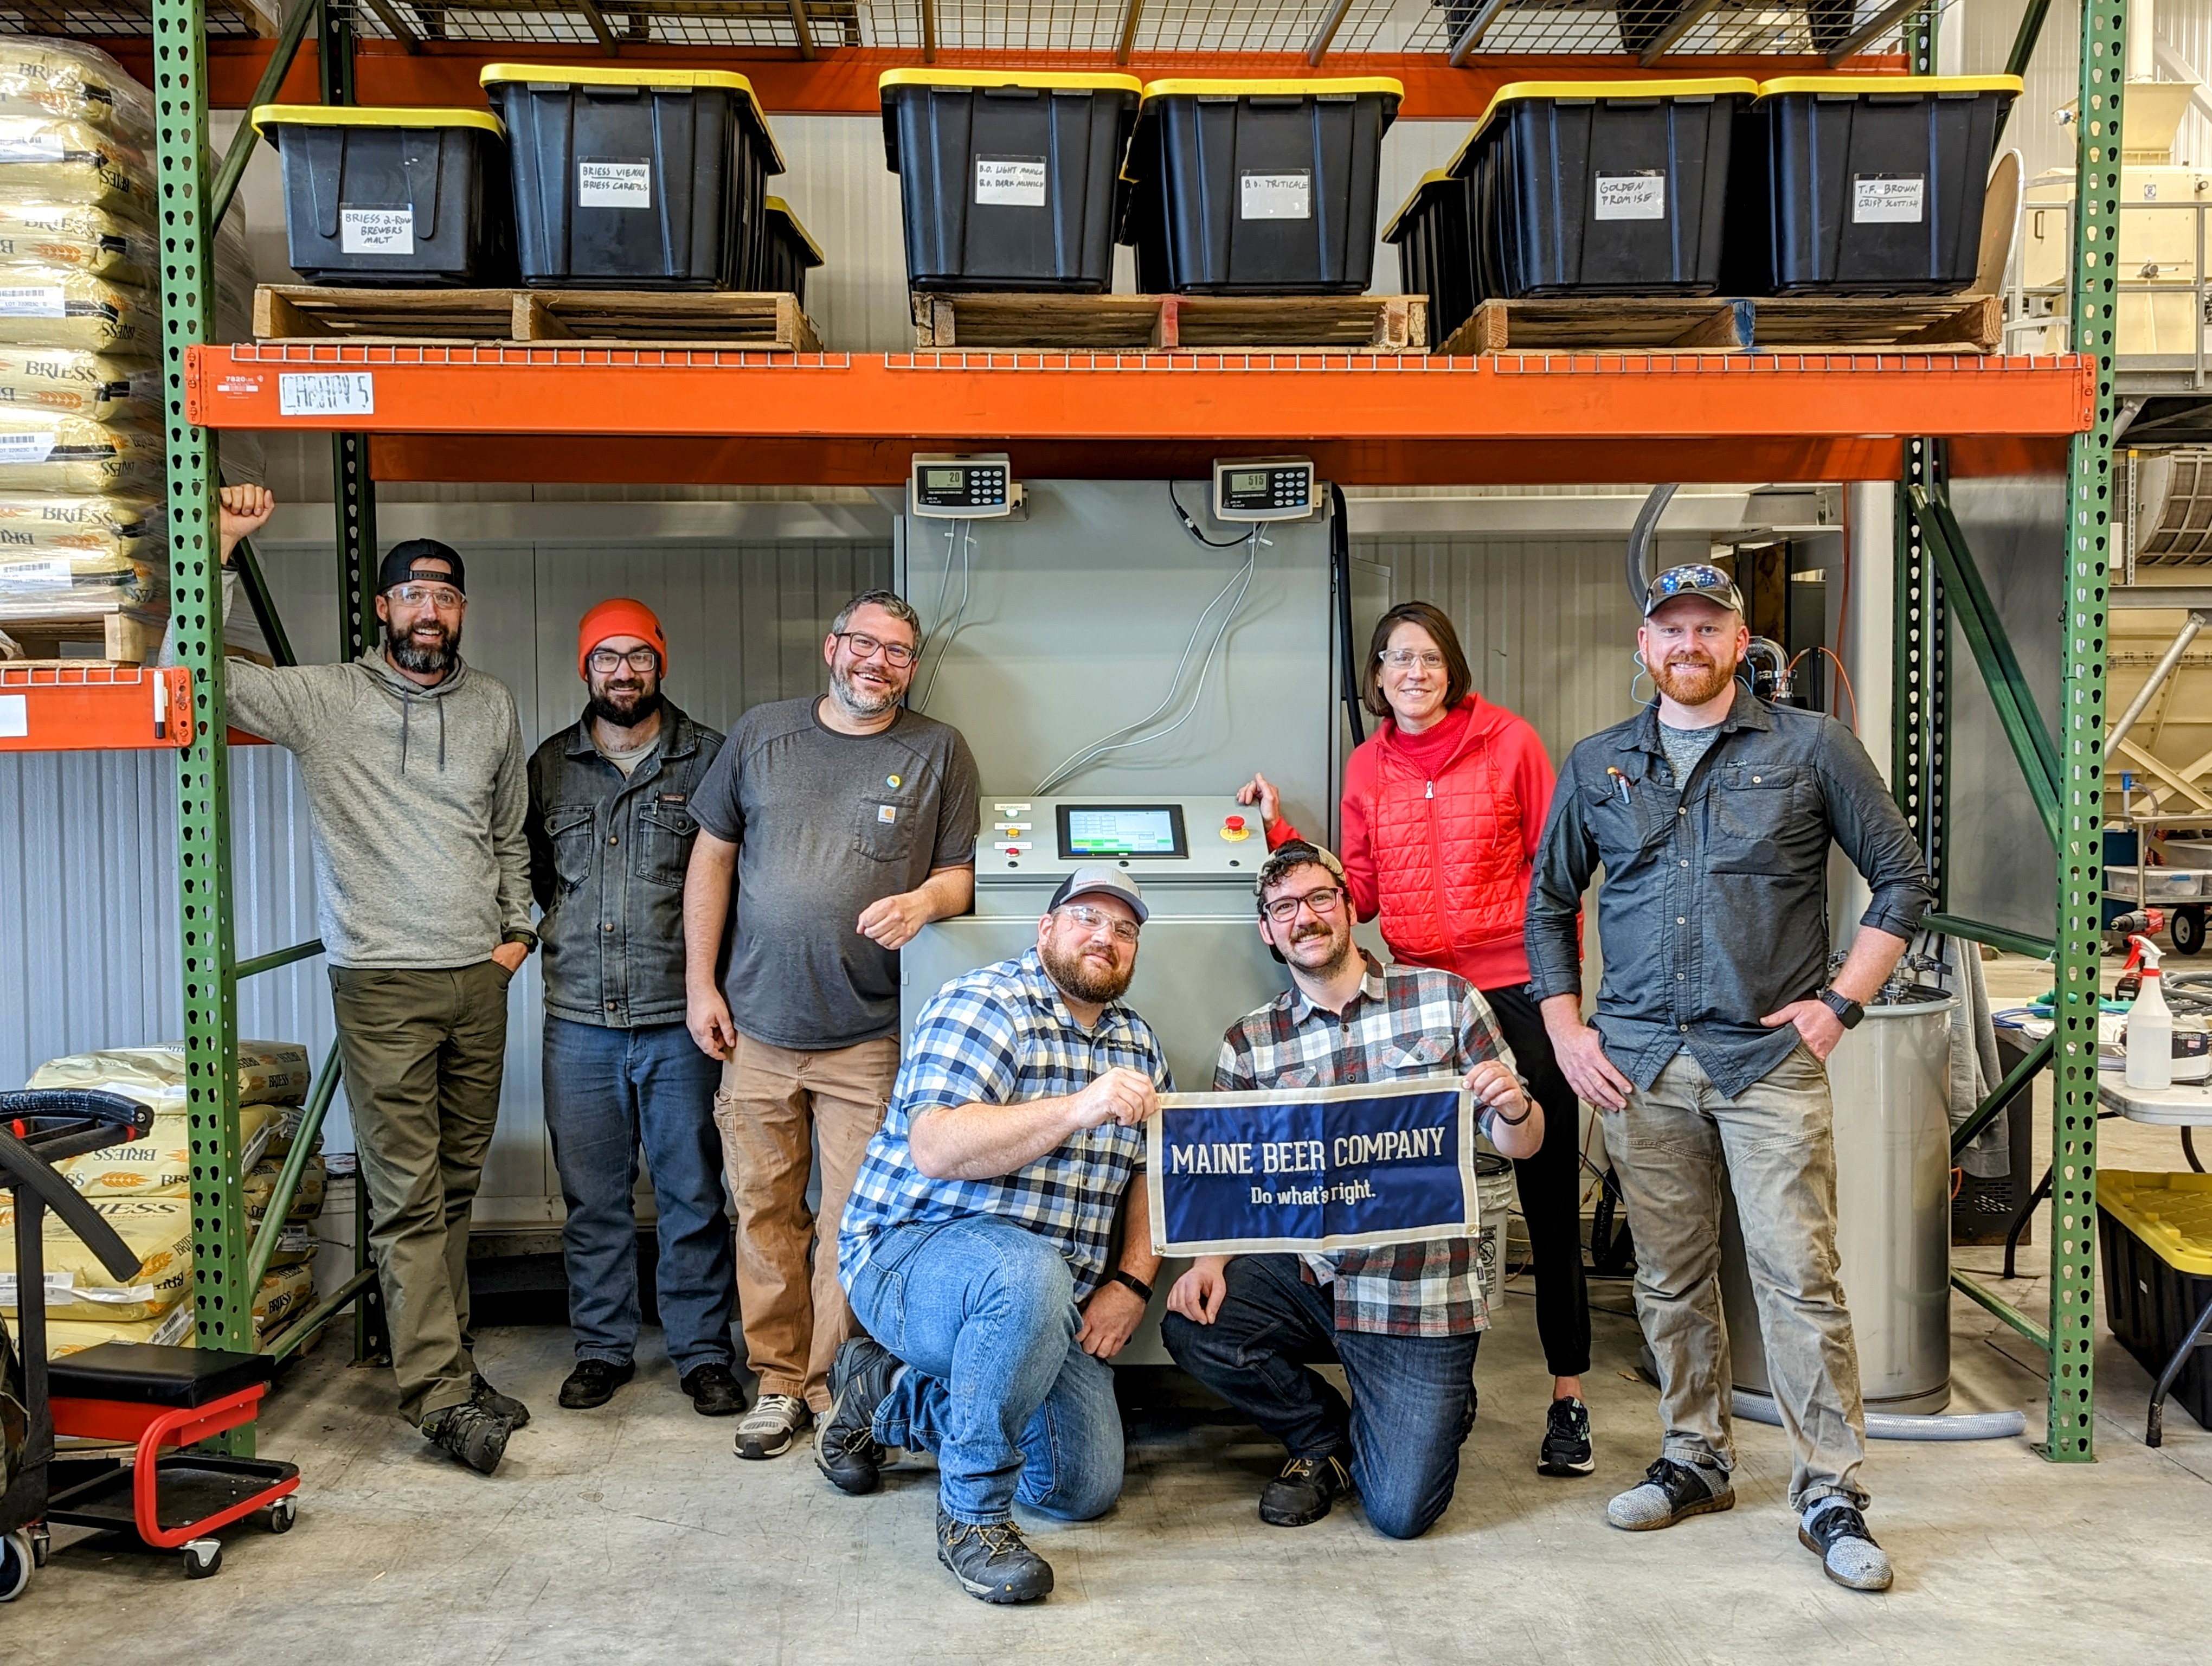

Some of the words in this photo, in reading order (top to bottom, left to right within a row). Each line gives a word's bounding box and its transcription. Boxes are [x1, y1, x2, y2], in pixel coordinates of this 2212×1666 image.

[583, 166, 611, 176] BRIESS
[616, 168, 646, 178] VIENNA
[996, 166, 1018, 174] LIGHT
[583, 180, 610, 190] BRIESS
[995, 179, 1014, 188] DARK
[1265, 180, 1308, 190] TRITICALE
[1600, 181, 1644, 194] GOLDEN
[1858, 185, 1876, 194] T.F.
[1884, 184, 1918, 195] BROWN
[1602, 193, 1653, 206] PROMISE
[1859, 198, 1882, 208] CRISP
[1885, 200, 1919, 208] SCOTTISH
[345, 214, 381, 224] BRIESS
[361, 226, 403, 235] BREWERS
[364, 236, 393, 244] MALT
[25, 361, 98, 382] BRIESS
[1249, 475, 1264, 485] 515
[41, 507, 113, 527] BRIESS
[268, 1073, 289, 1088] BRIESS
[93, 1147, 157, 1162] BRIESS
[1171, 1143, 1253, 1176] MAINE
[1262, 1139, 1326, 1174] BEER
[1334, 1126, 1446, 1168] COMPANY
[1251, 1186, 1272, 1205] Do
[1276, 1186, 1329, 1206] what's
[1331, 1178, 1376, 1206] right.
[268, 1291, 292, 1314] BRIESS
